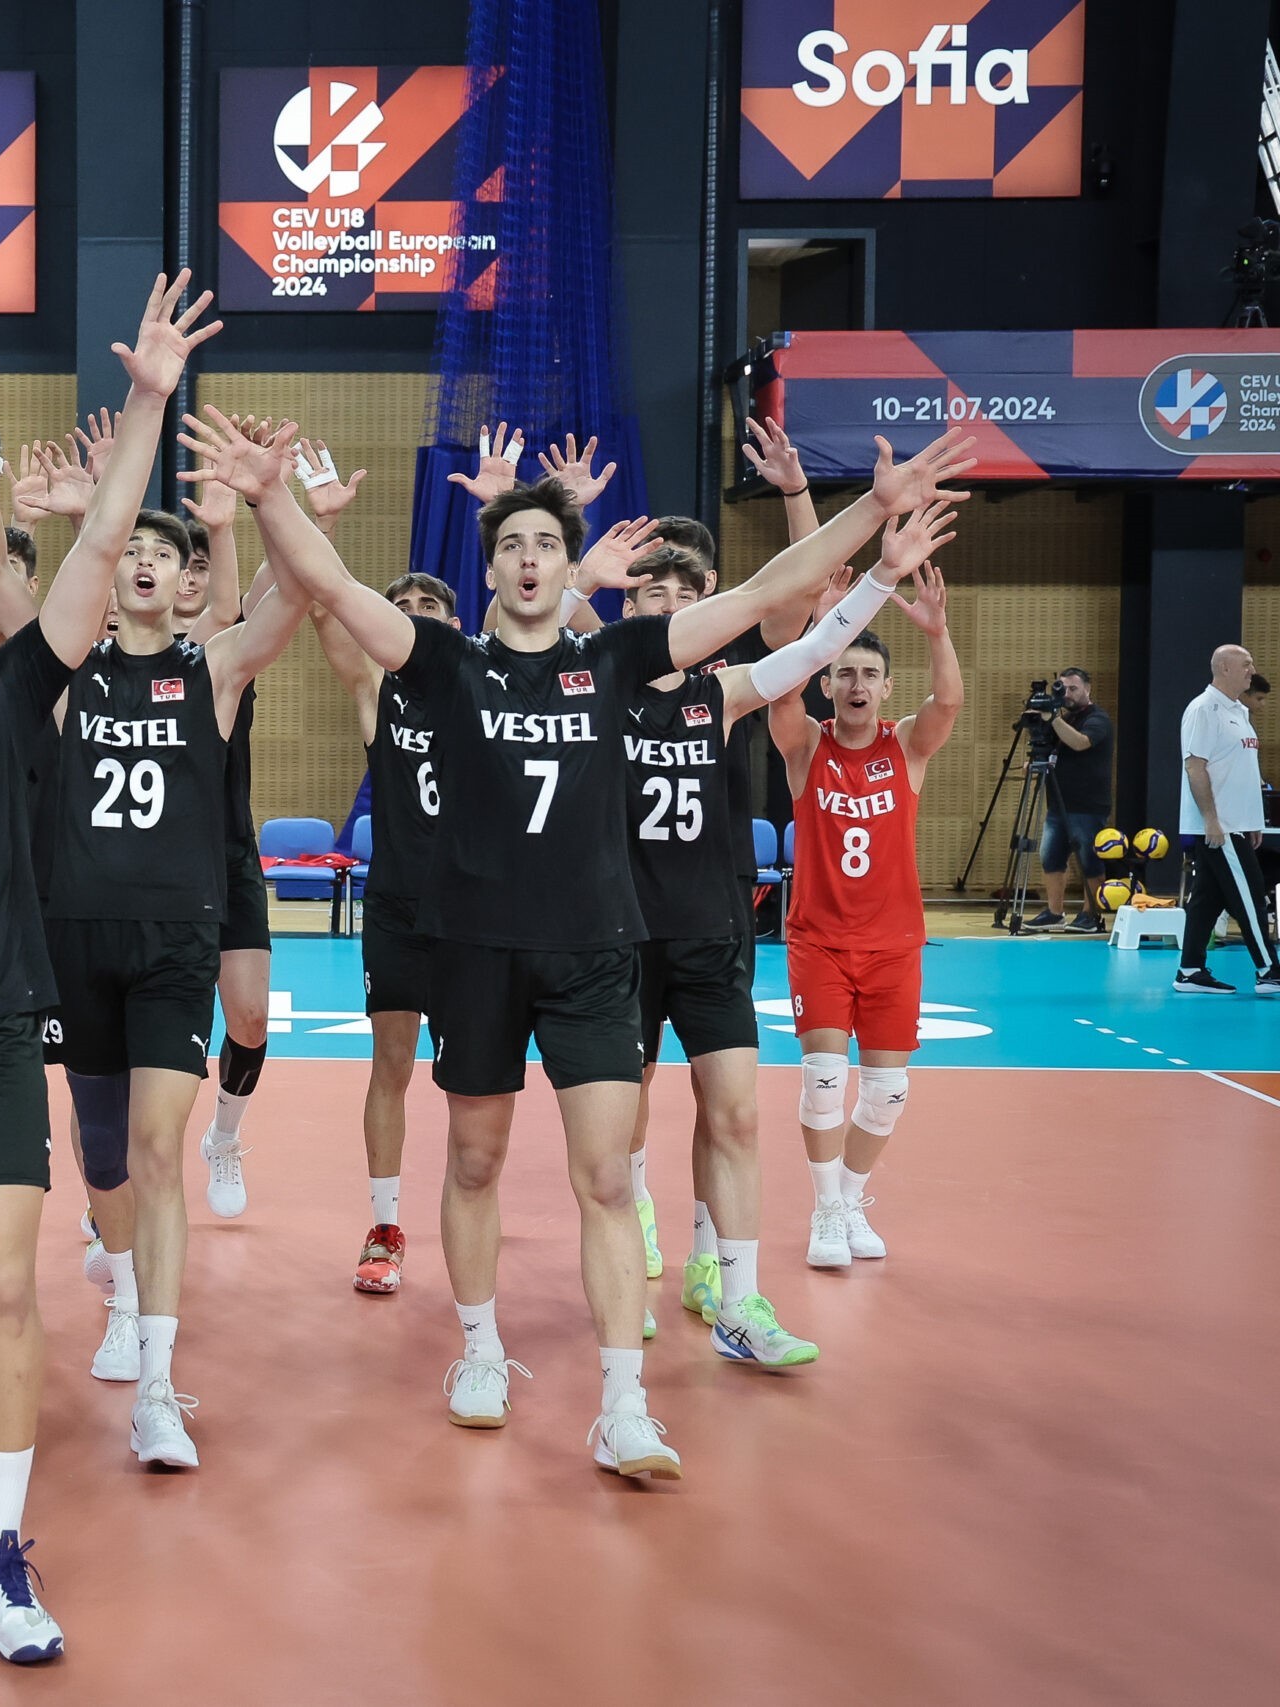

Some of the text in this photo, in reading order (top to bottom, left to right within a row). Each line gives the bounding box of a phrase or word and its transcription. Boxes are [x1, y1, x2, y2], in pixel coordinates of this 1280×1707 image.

[792, 24, 1030, 107] Sofia
[272, 208, 365, 228] CEV U18
[272, 231, 496, 255] Volleyball European
[272, 254, 436, 277] Championship
[272, 277, 327, 296] 2024
[1240, 375, 1271, 387] CEV
[1239, 419, 1276, 431] 2024
[79, 711, 187, 747] VESTEL
[480, 709, 598, 743] VESTEL
[623, 735, 716, 767] VESTEL
[91, 757, 165, 829] 29
[416, 761, 440, 816] 6
[523, 759, 559, 833] 7
[816, 787, 896, 819] VESTEL
[639, 776, 703, 842] 25
[841, 827, 870, 878] 8
[794, 994, 804, 1017] 8
